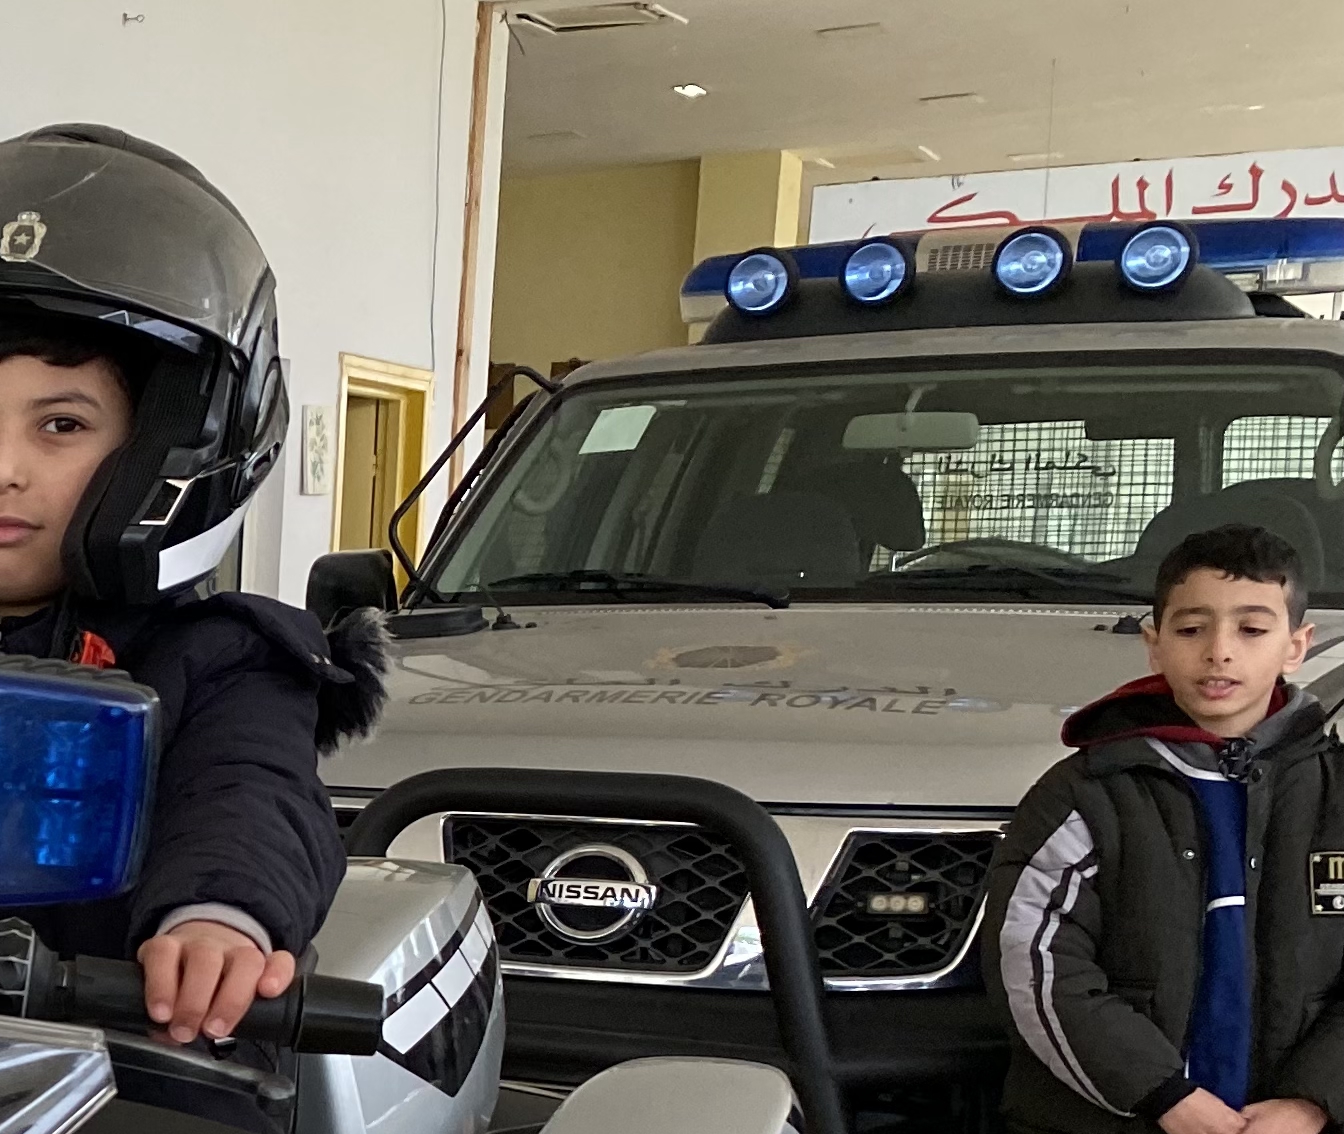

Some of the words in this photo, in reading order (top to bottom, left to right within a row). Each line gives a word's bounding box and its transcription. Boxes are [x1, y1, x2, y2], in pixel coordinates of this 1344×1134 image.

[863, 167, 1175, 238] الملك
[1192, 160, 1344, 219] درك
[409, 689, 731, 706] GENDARMERIE
[750, 692, 947, 715] ROYALE
[538, 883, 640, 903] NISSAN
